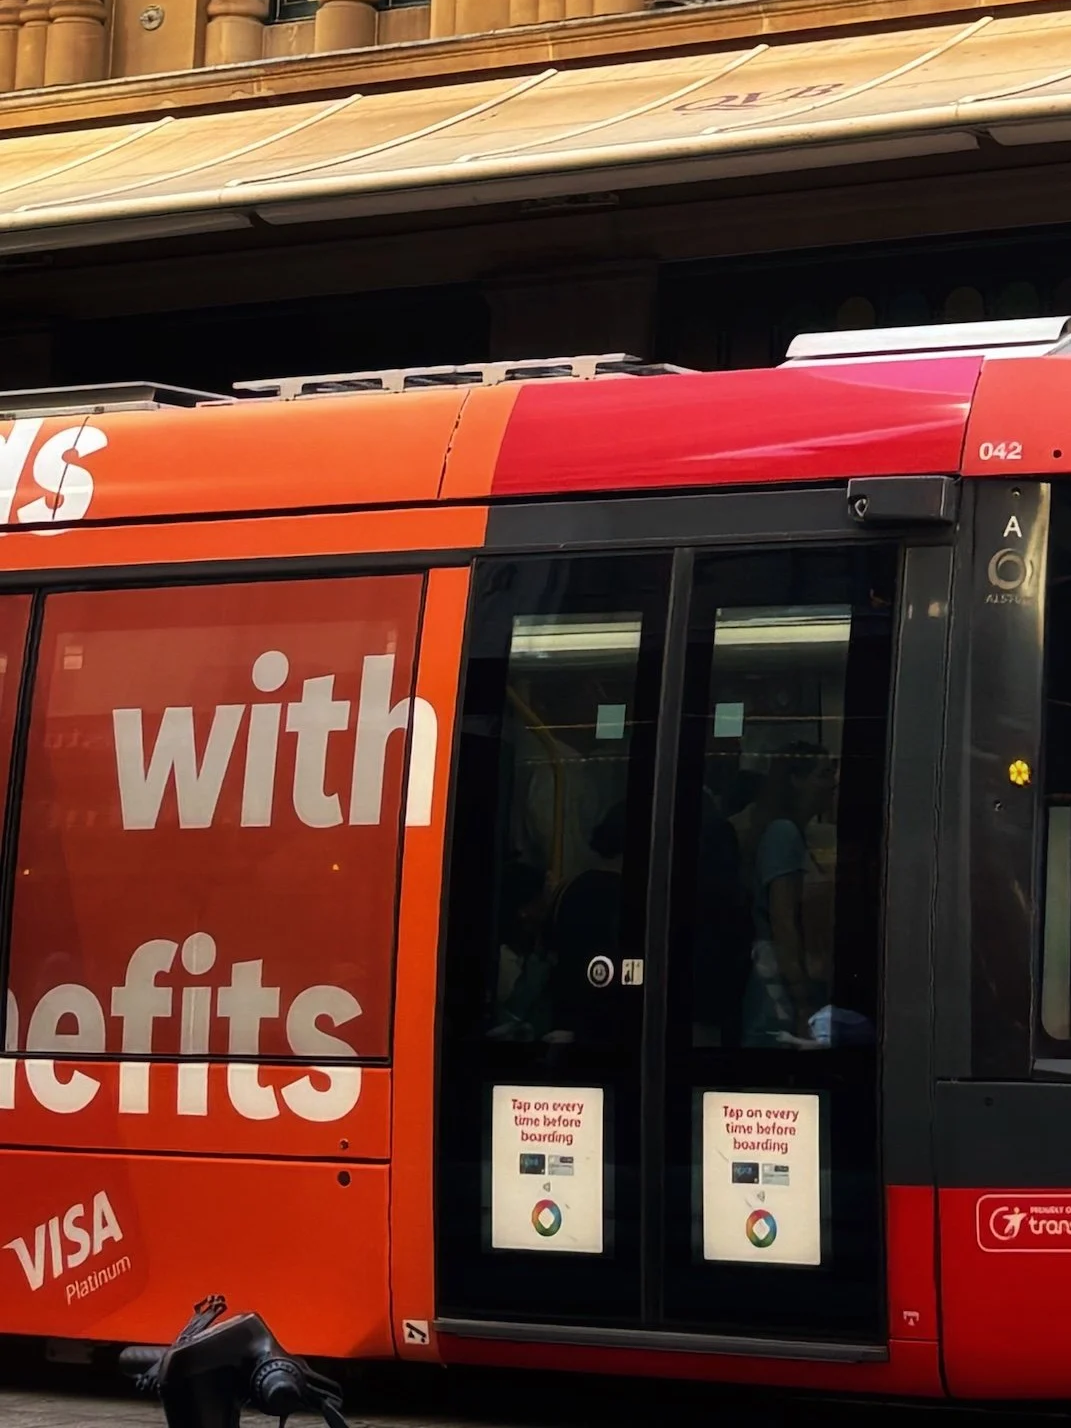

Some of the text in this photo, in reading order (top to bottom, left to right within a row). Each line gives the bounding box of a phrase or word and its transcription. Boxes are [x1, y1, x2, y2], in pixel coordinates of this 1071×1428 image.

[979, 441, 1023, 461] 042
[1003, 515, 1023, 538] A
[113, 650, 438, 831] with
[511, 1099, 584, 1115] Tap on every
[723, 1105, 800, 1123] Tap on every
[514, 1114, 581, 1127] time before
[726, 1122, 796, 1136] time before
[520, 1130, 574, 1146] boarding
[733, 1137, 789, 1155] boarding
[2, 1190, 123, 1291] VISA
[65, 1255, 131, 1305] Platinum
